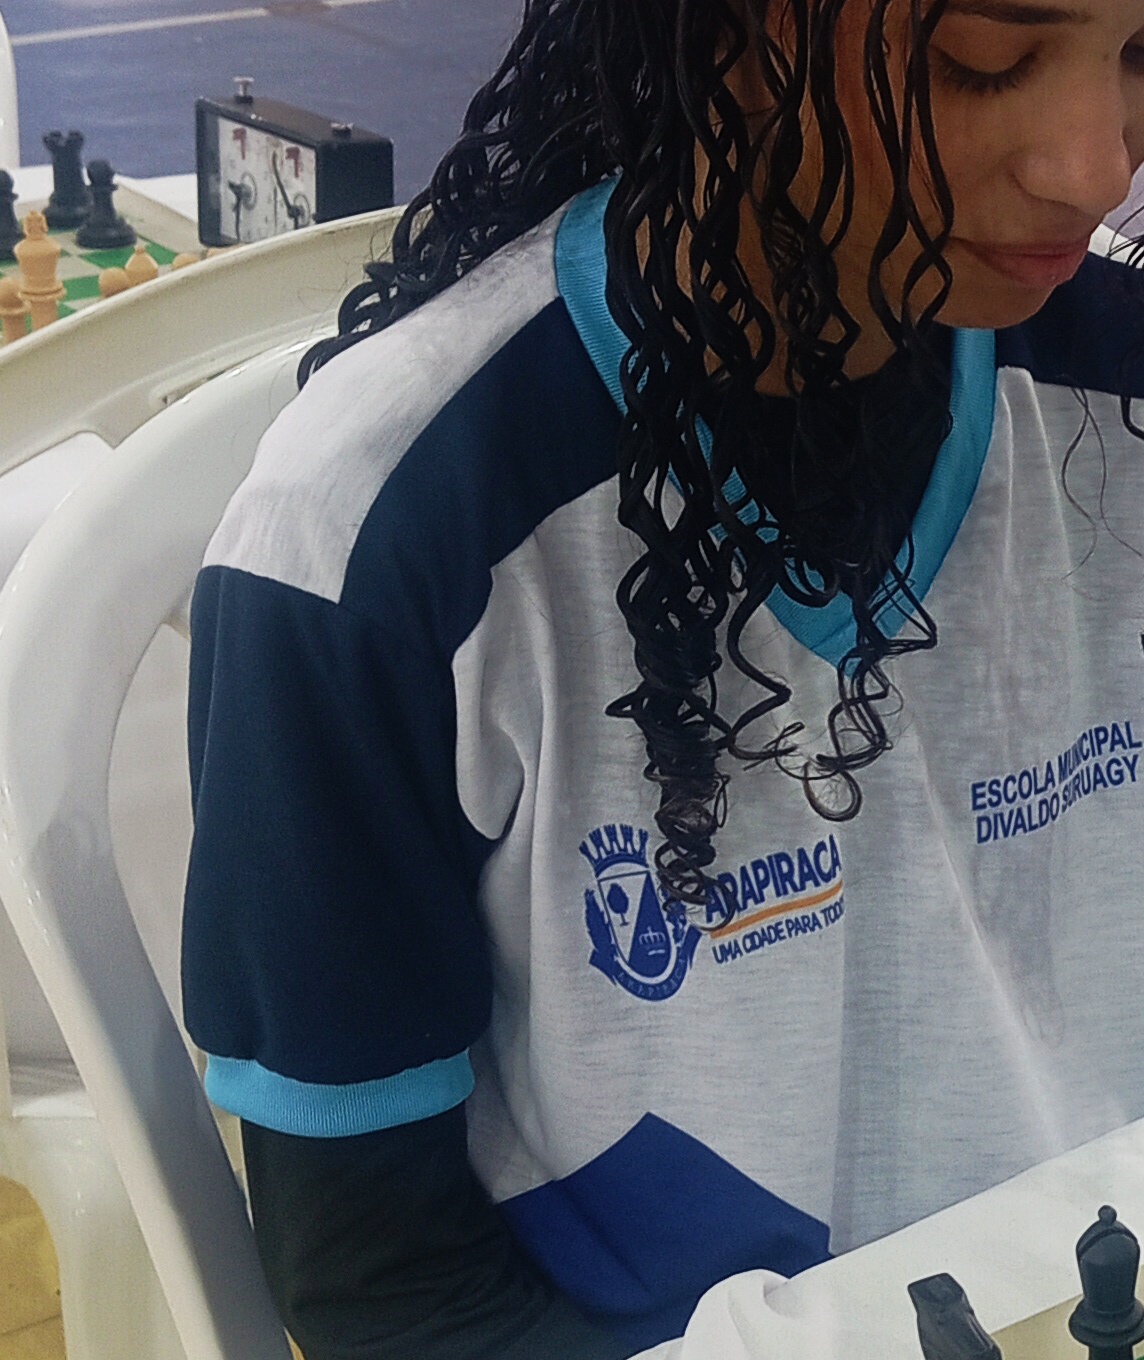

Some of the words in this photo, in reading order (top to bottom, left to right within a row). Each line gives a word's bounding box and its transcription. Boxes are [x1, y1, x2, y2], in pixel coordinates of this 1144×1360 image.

[971, 760, 1056, 811] ESCOLA
[976, 792, 1060, 844] DIVALDO
[712, 939, 743, 964] UMA
[742, 921, 787, 953] CIDADE
[785, 912, 822, 938] PARA
